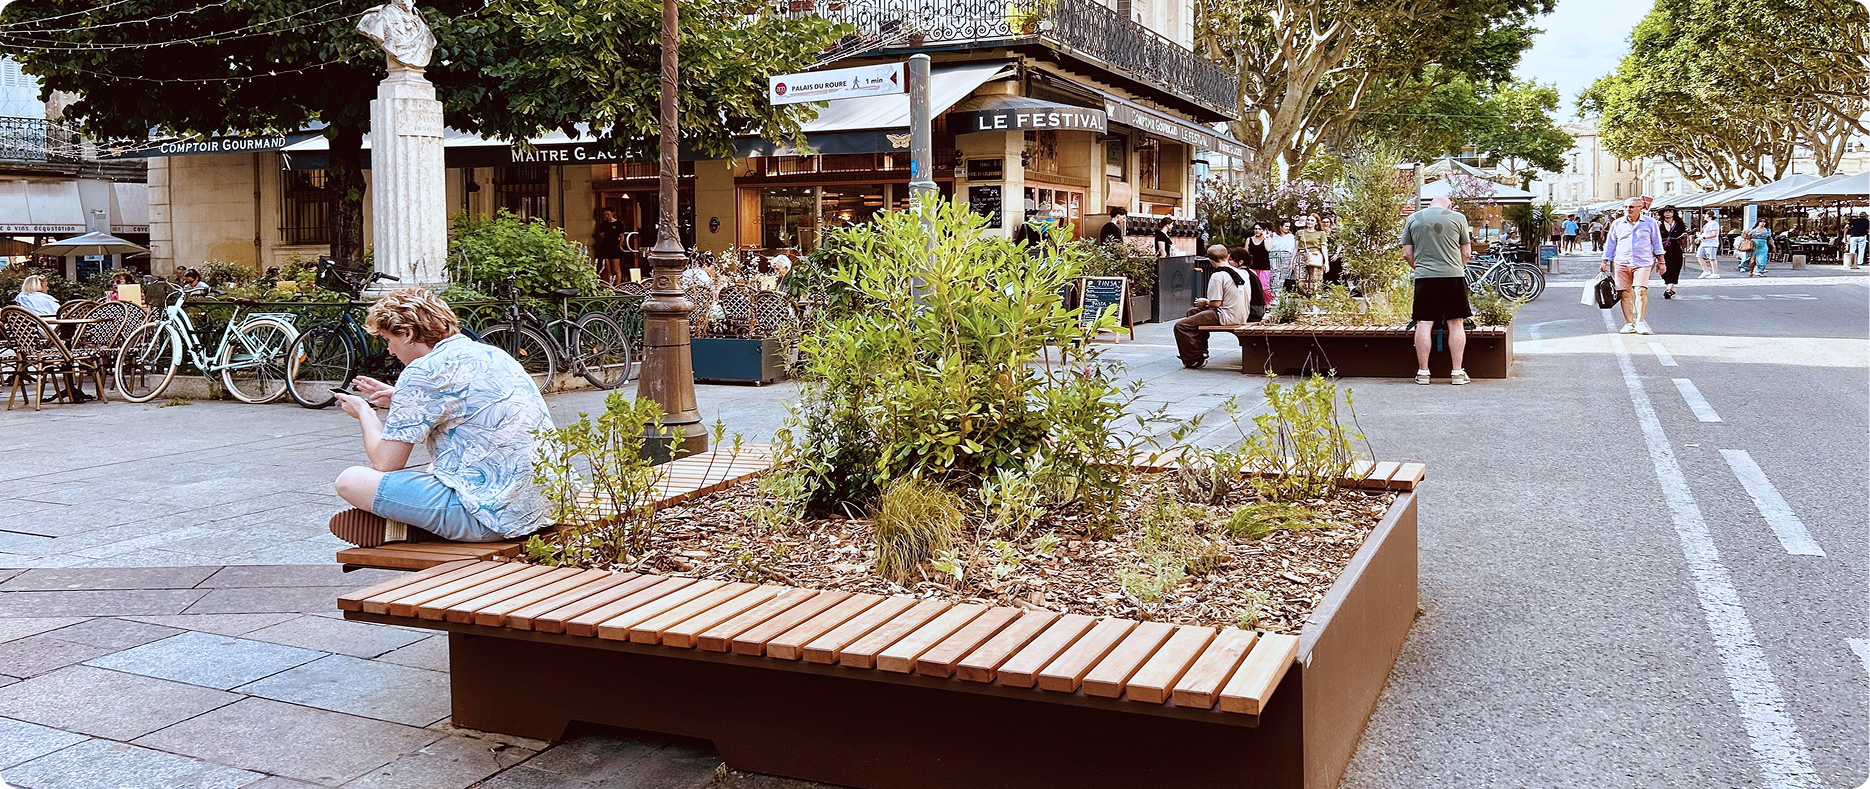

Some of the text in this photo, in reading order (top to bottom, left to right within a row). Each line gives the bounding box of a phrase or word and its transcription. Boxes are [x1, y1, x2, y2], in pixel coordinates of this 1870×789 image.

[792, 83, 813, 92] PALAIS
[825, 80, 847, 88] ROURE
[979, 112, 1104, 130] LE FESTIVAL
[1181, 128, 1188, 141] LE
[160, 137, 286, 154] COMPTOIR GOURMAND
